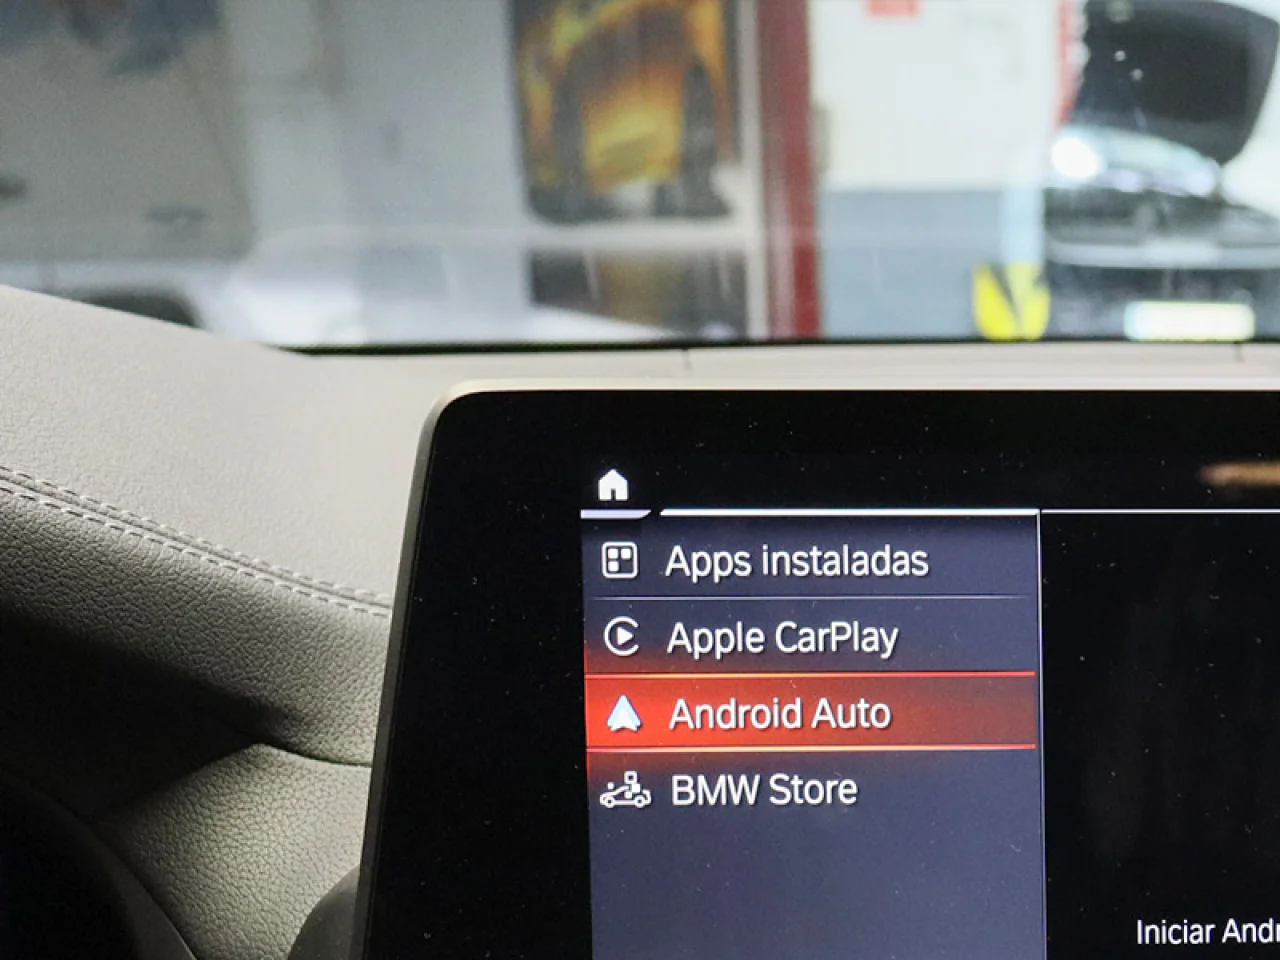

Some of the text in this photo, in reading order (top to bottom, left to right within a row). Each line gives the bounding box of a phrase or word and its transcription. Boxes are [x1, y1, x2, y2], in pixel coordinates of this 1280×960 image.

[665, 543, 929, 584] Apps instaladas
[666, 620, 899, 660] Apple CarPlay
[668, 696, 893, 730] Android Auto
[671, 772, 858, 806] BMW Store
[1137, 919, 1216, 945] Iniciar
